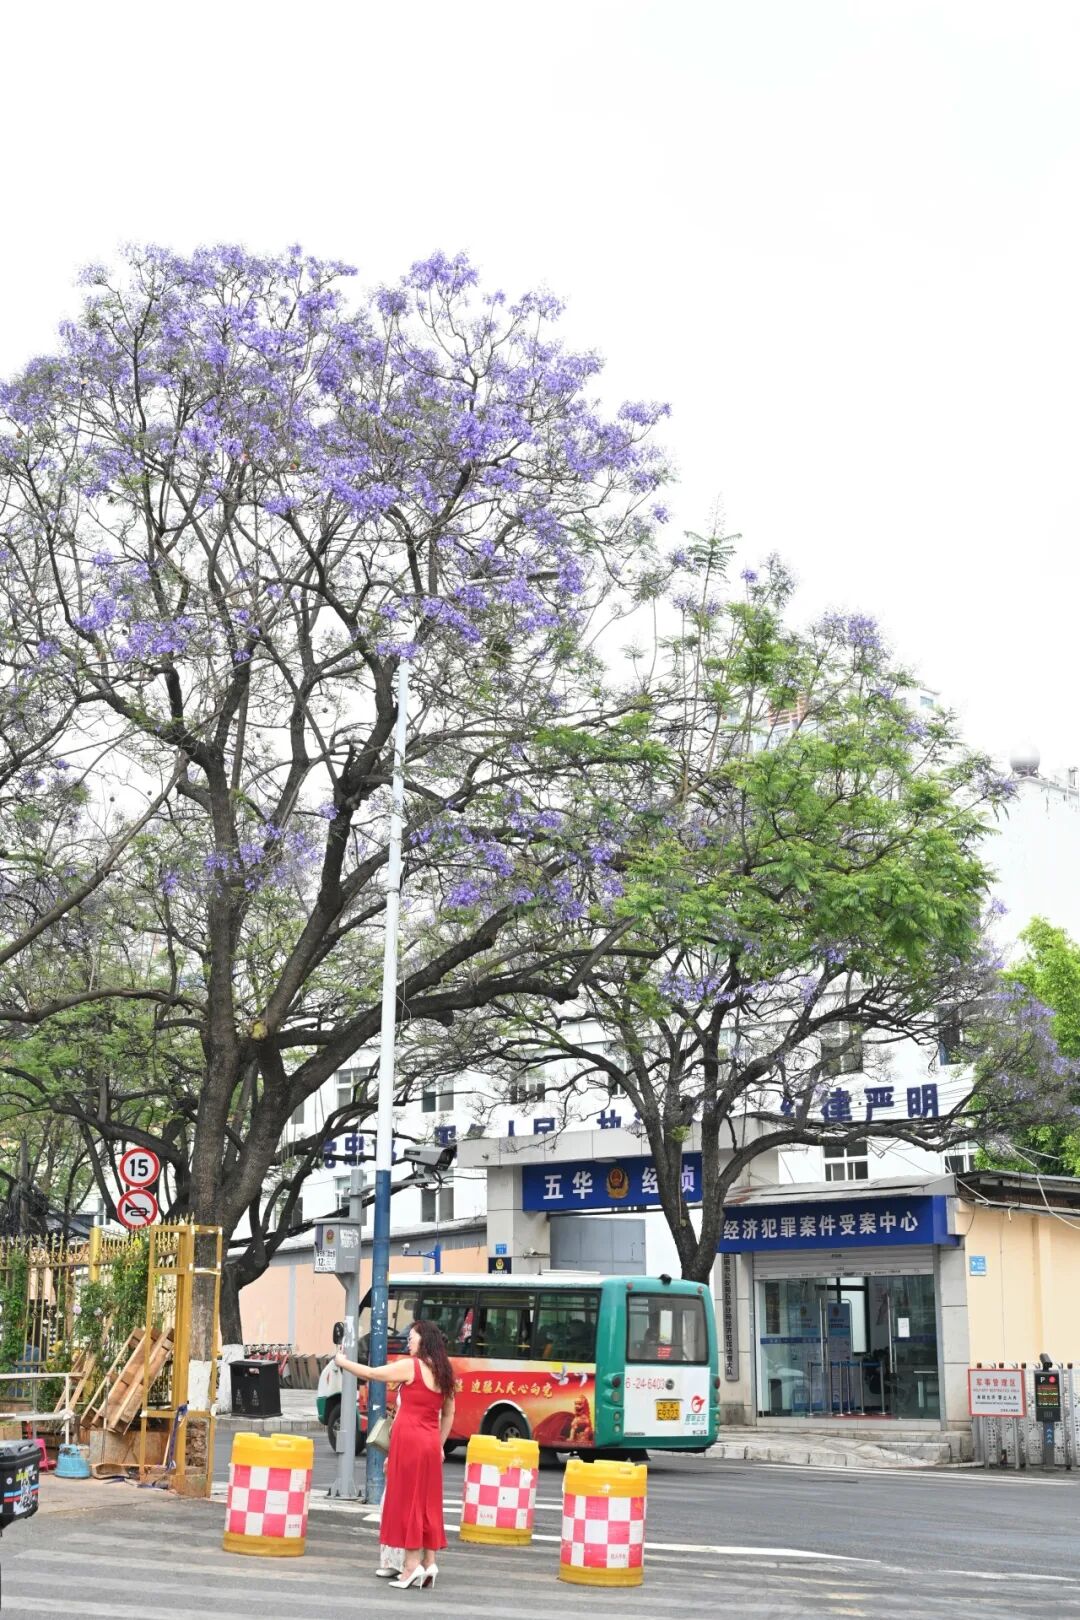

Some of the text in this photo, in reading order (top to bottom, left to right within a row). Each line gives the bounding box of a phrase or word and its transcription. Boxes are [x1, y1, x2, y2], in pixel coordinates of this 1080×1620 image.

[130, 1158, 149, 1177] 15
[543, 1171, 593, 1200] 五华
[723, 1210, 919, 1240] 经济犯罪案件受案中心
